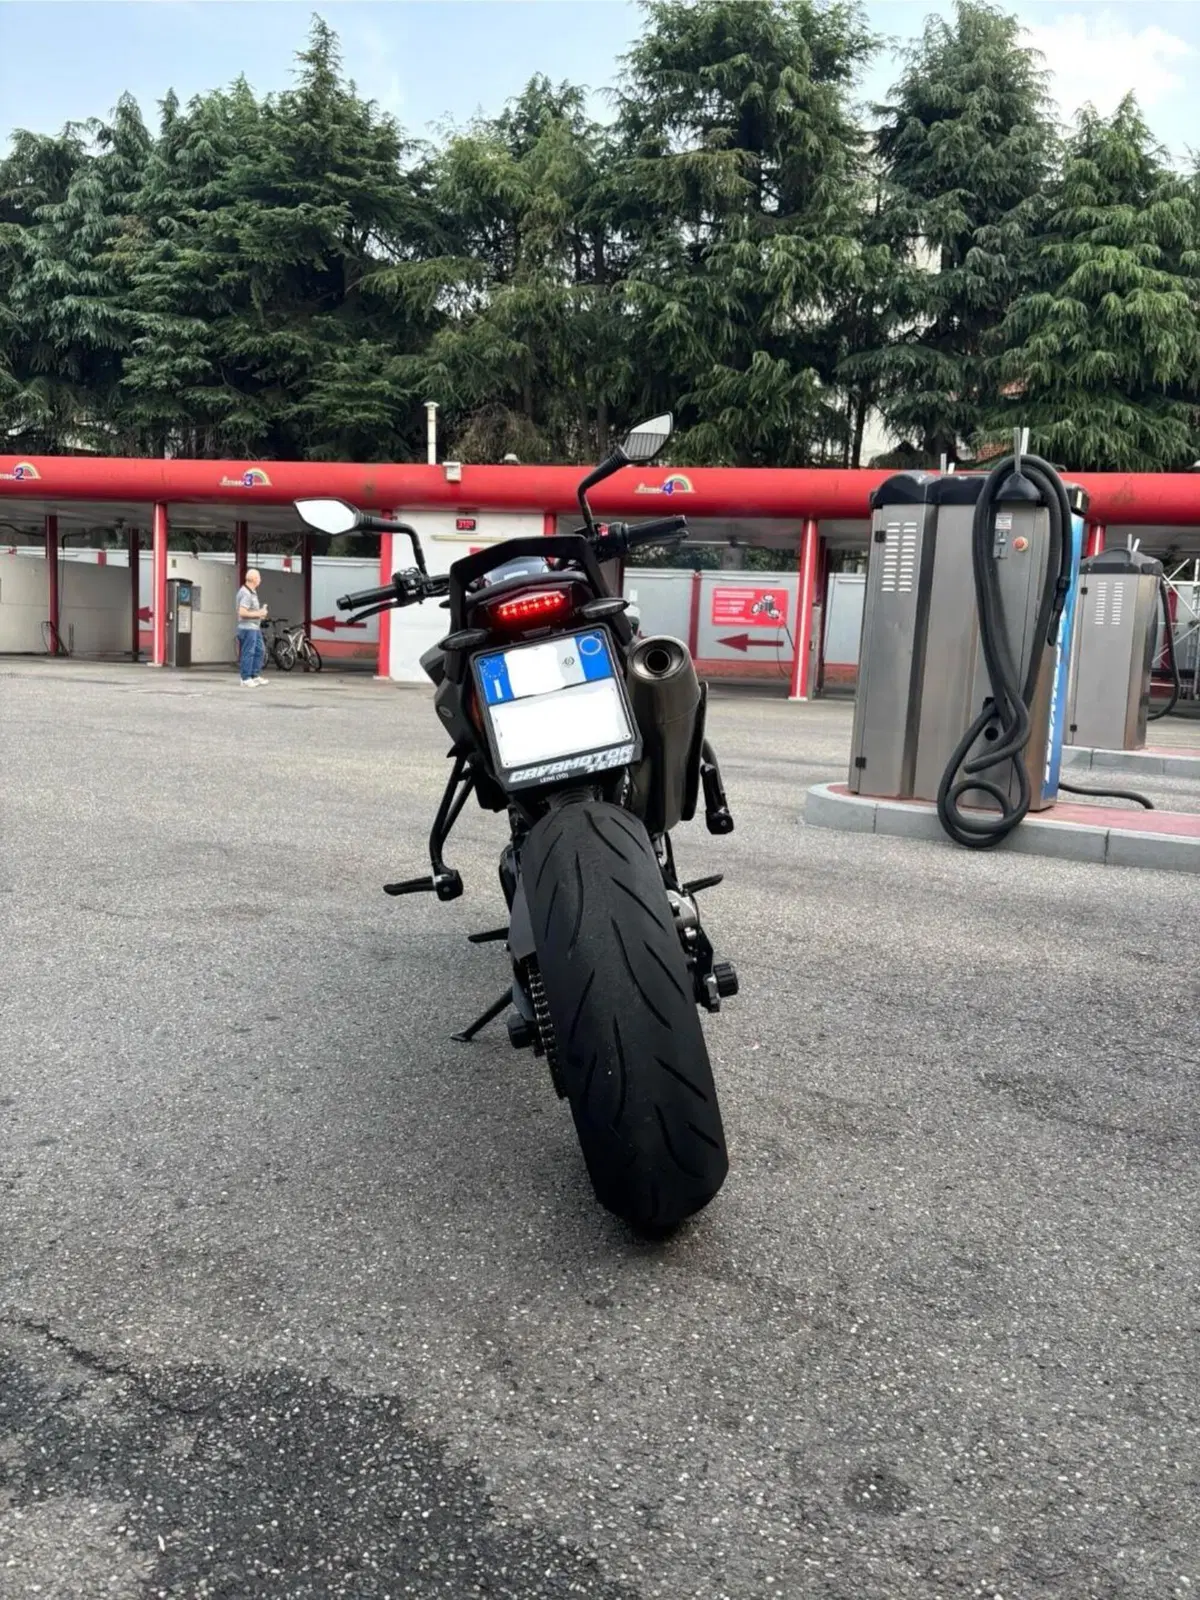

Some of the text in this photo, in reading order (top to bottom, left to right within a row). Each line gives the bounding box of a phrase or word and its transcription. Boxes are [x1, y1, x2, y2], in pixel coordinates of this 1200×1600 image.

[15, 467, 25, 480] 2
[244, 473, 254, 487] 3
[662, 480, 674, 494] 4
